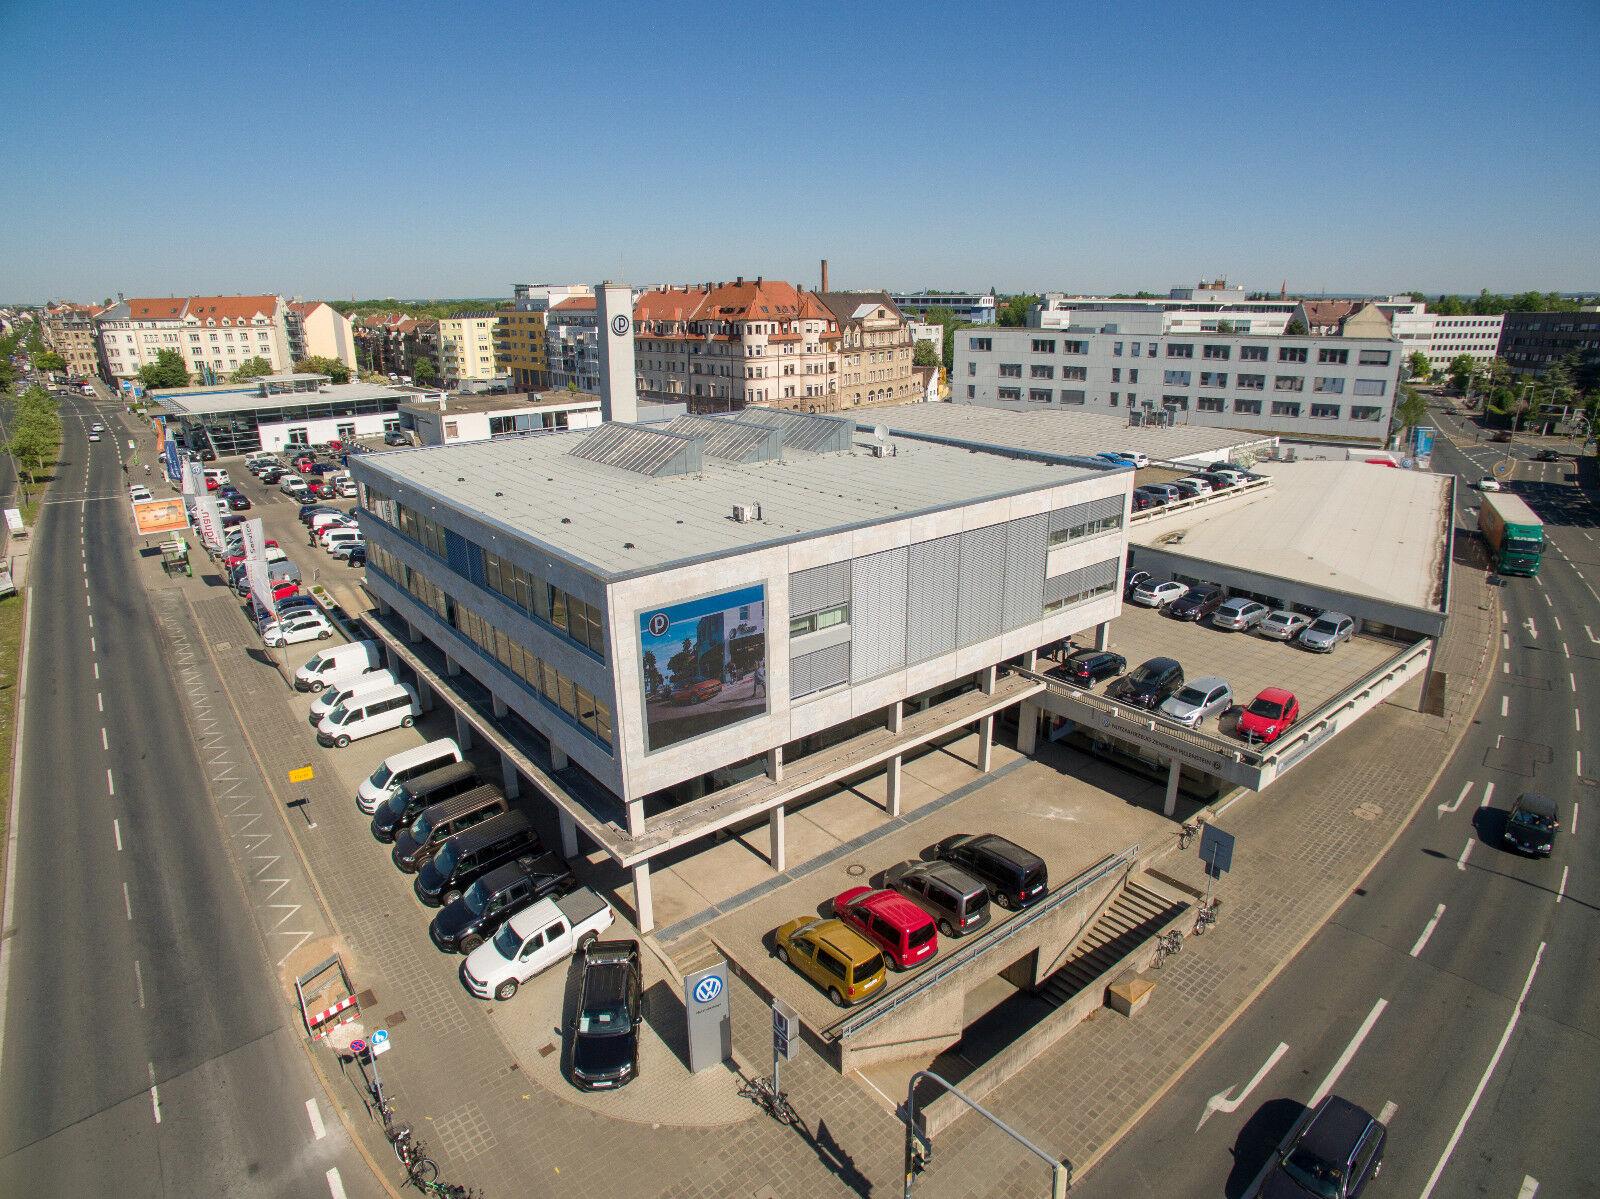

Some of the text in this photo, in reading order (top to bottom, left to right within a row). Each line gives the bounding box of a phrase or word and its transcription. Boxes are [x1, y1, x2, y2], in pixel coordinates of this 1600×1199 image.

[245, 523, 256, 554] Service
[695, 977, 722, 1003] VW
[774, 1010, 786, 1033] U
